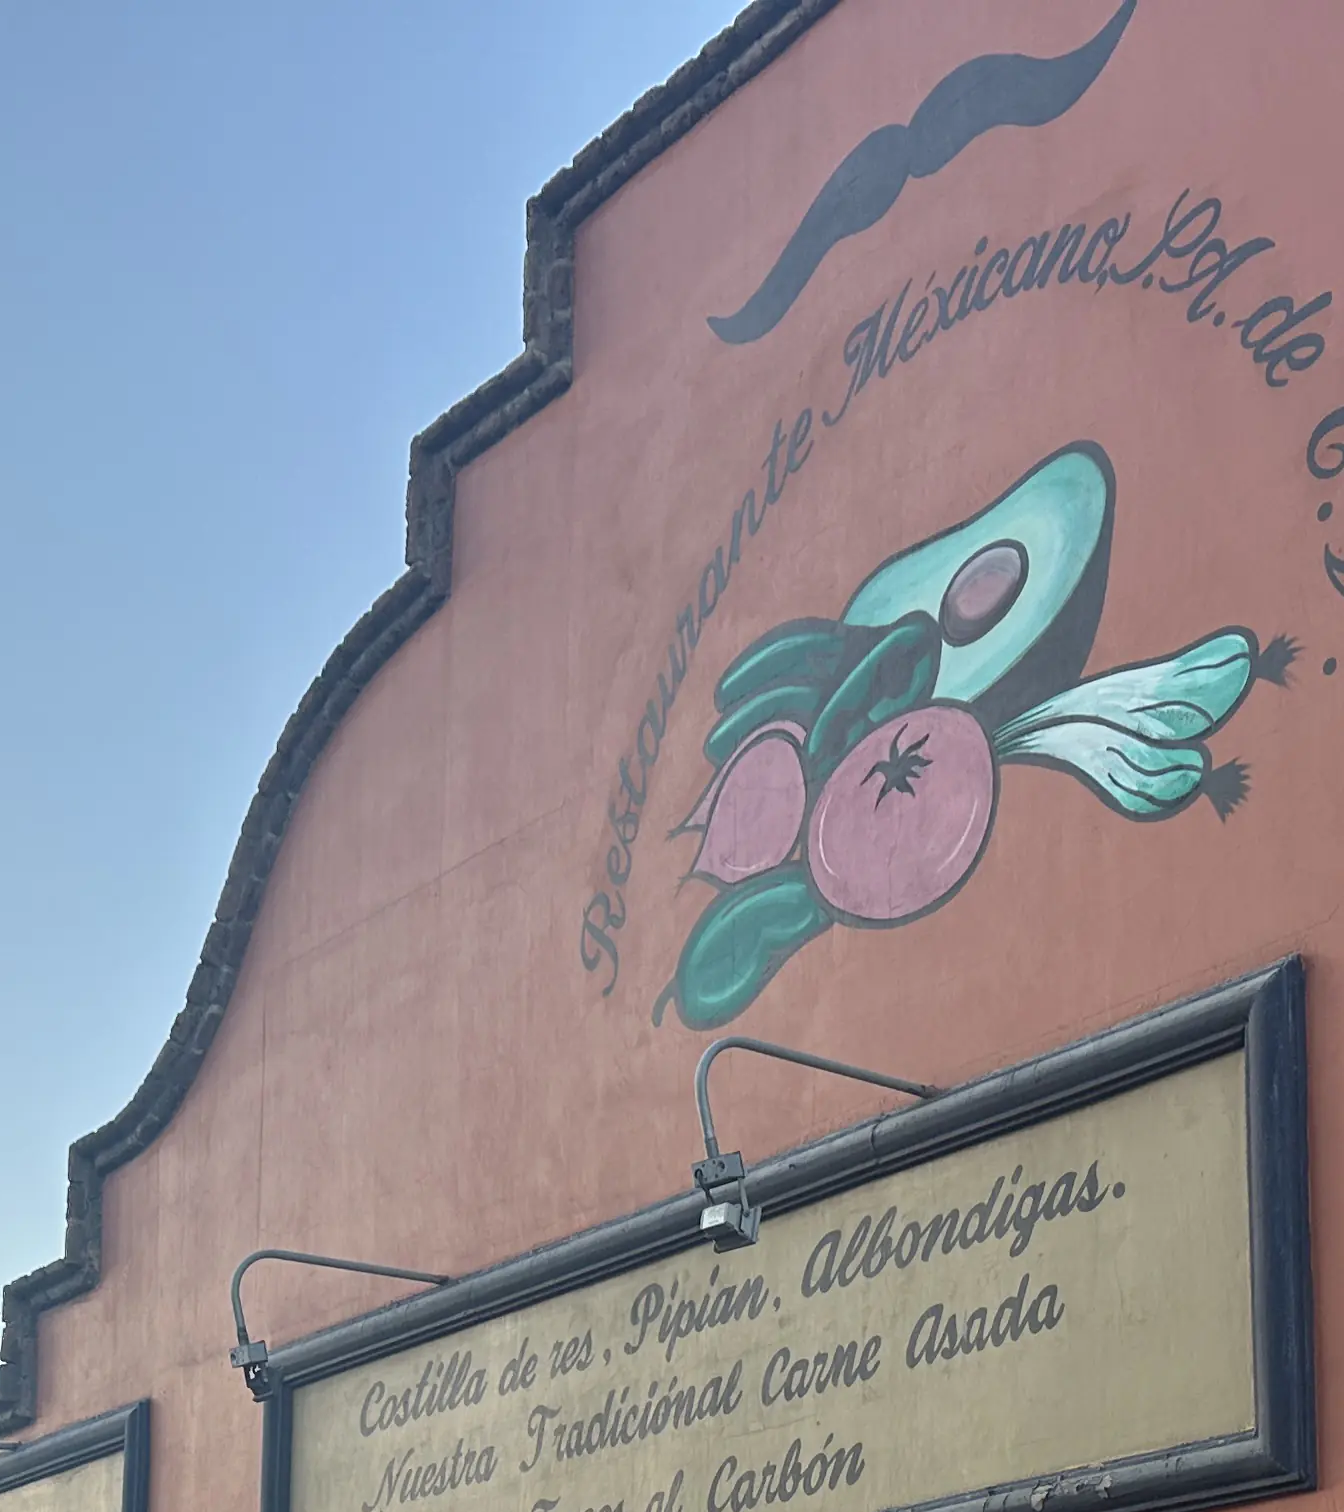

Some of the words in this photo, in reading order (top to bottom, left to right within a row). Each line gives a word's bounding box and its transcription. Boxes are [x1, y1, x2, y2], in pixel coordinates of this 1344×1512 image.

[579, 407, 814, 998] Restaurante
[1231, 290, 1333, 387] de
[360, 1350, 487, 1437] Costilla
[498, 1336, 537, 1396] de
[761, 1335, 882, 1407] Carne
[905, 1272, 1066, 1369] Asada
